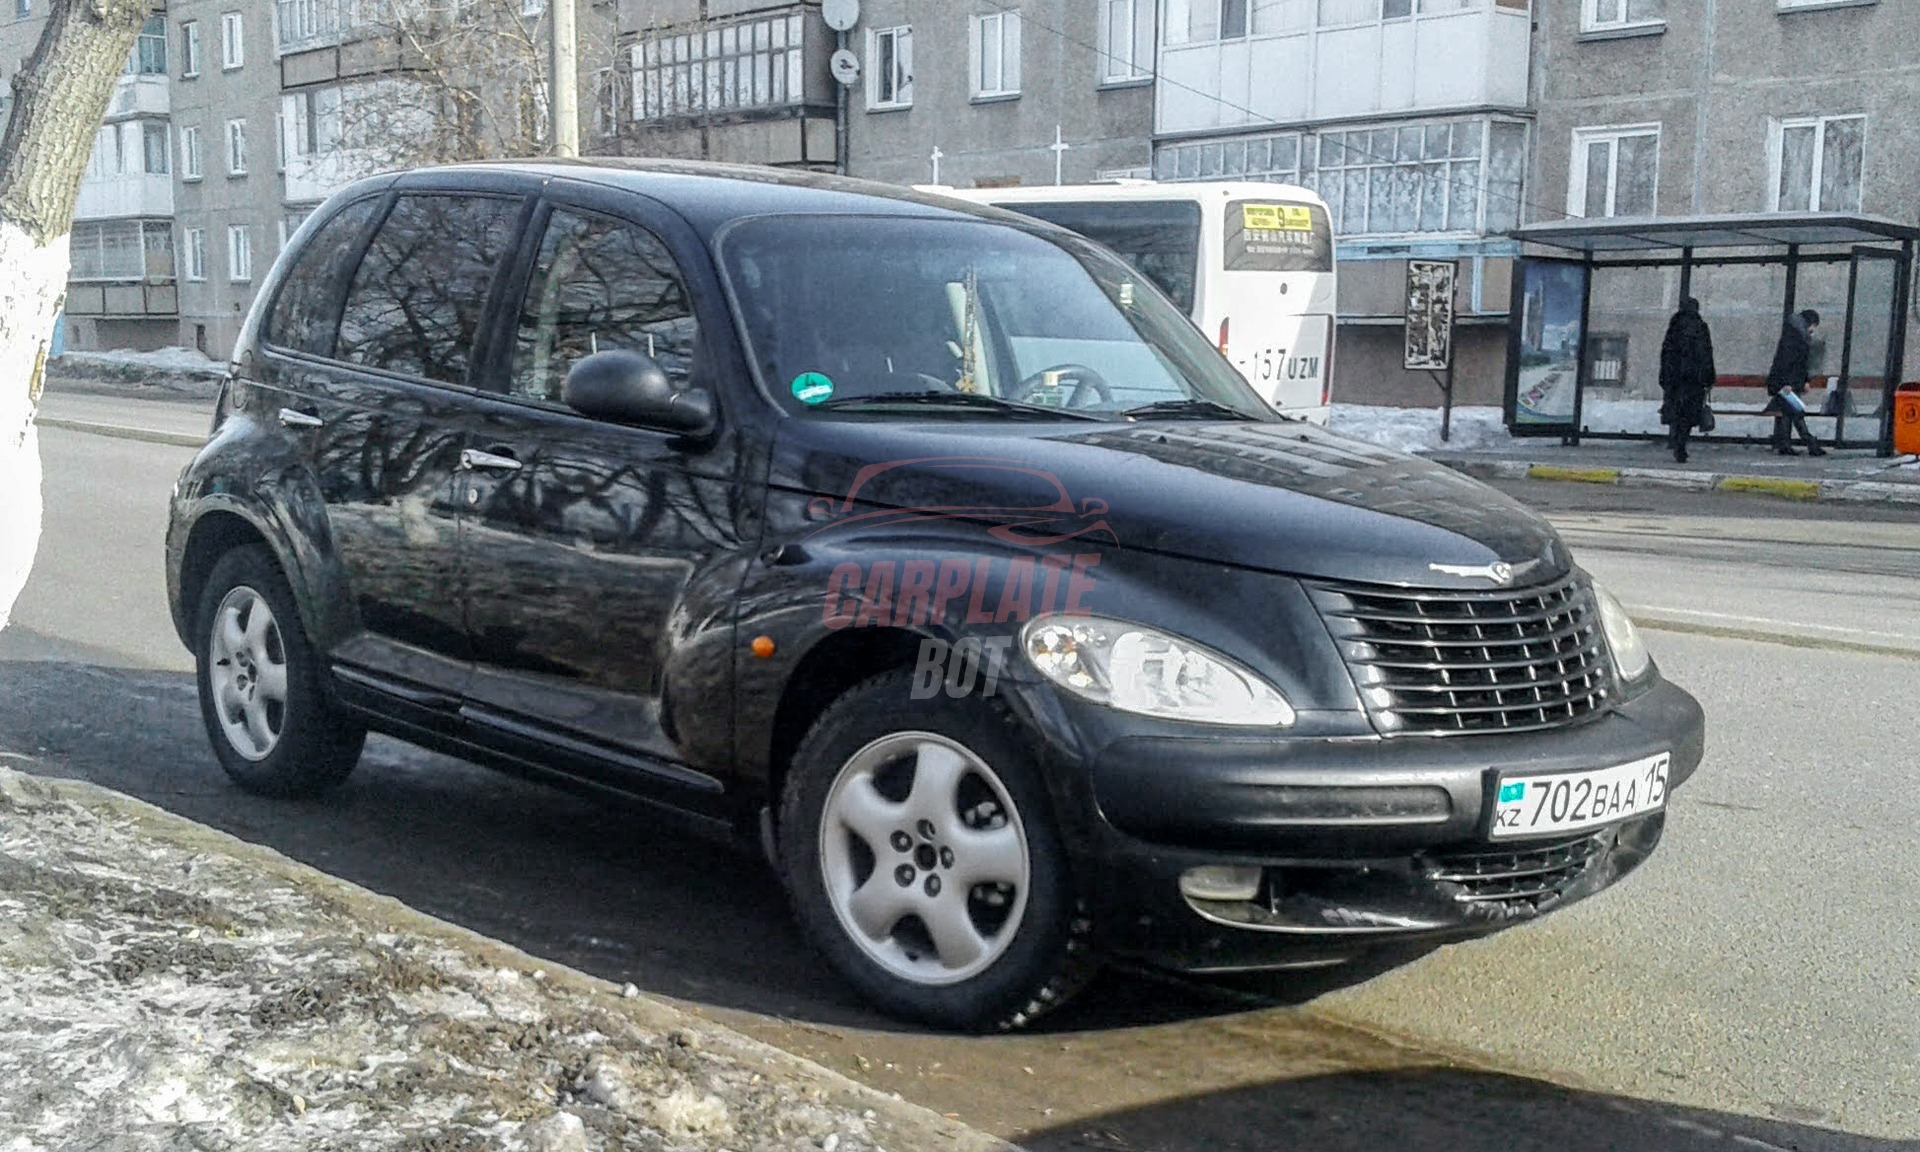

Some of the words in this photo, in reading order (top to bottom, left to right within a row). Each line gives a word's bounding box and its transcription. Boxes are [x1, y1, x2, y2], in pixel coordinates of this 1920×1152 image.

[1277, 206, 1286, 228] 9
[1645, 759, 1668, 805] 15
[1495, 808, 1522, 828] KZ
